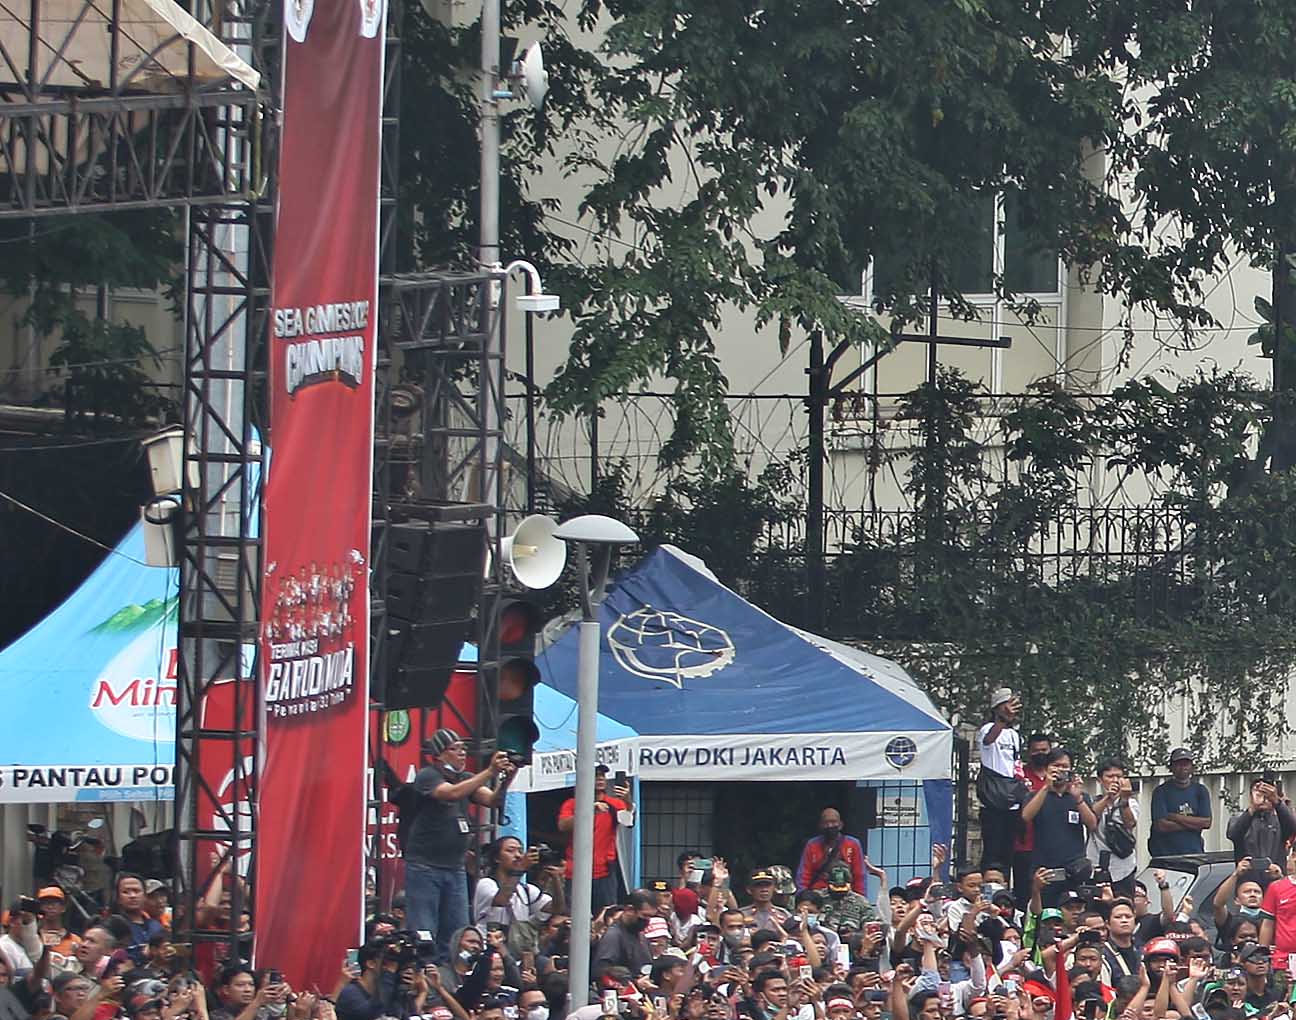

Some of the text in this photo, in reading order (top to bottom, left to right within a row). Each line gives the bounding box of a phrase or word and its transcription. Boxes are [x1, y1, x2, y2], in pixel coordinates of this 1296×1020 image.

[274, 308, 304, 337] SEA
[639, 745, 847, 768] ROV DKI JAKARTA
[13, 766, 122, 789] PANTAU
